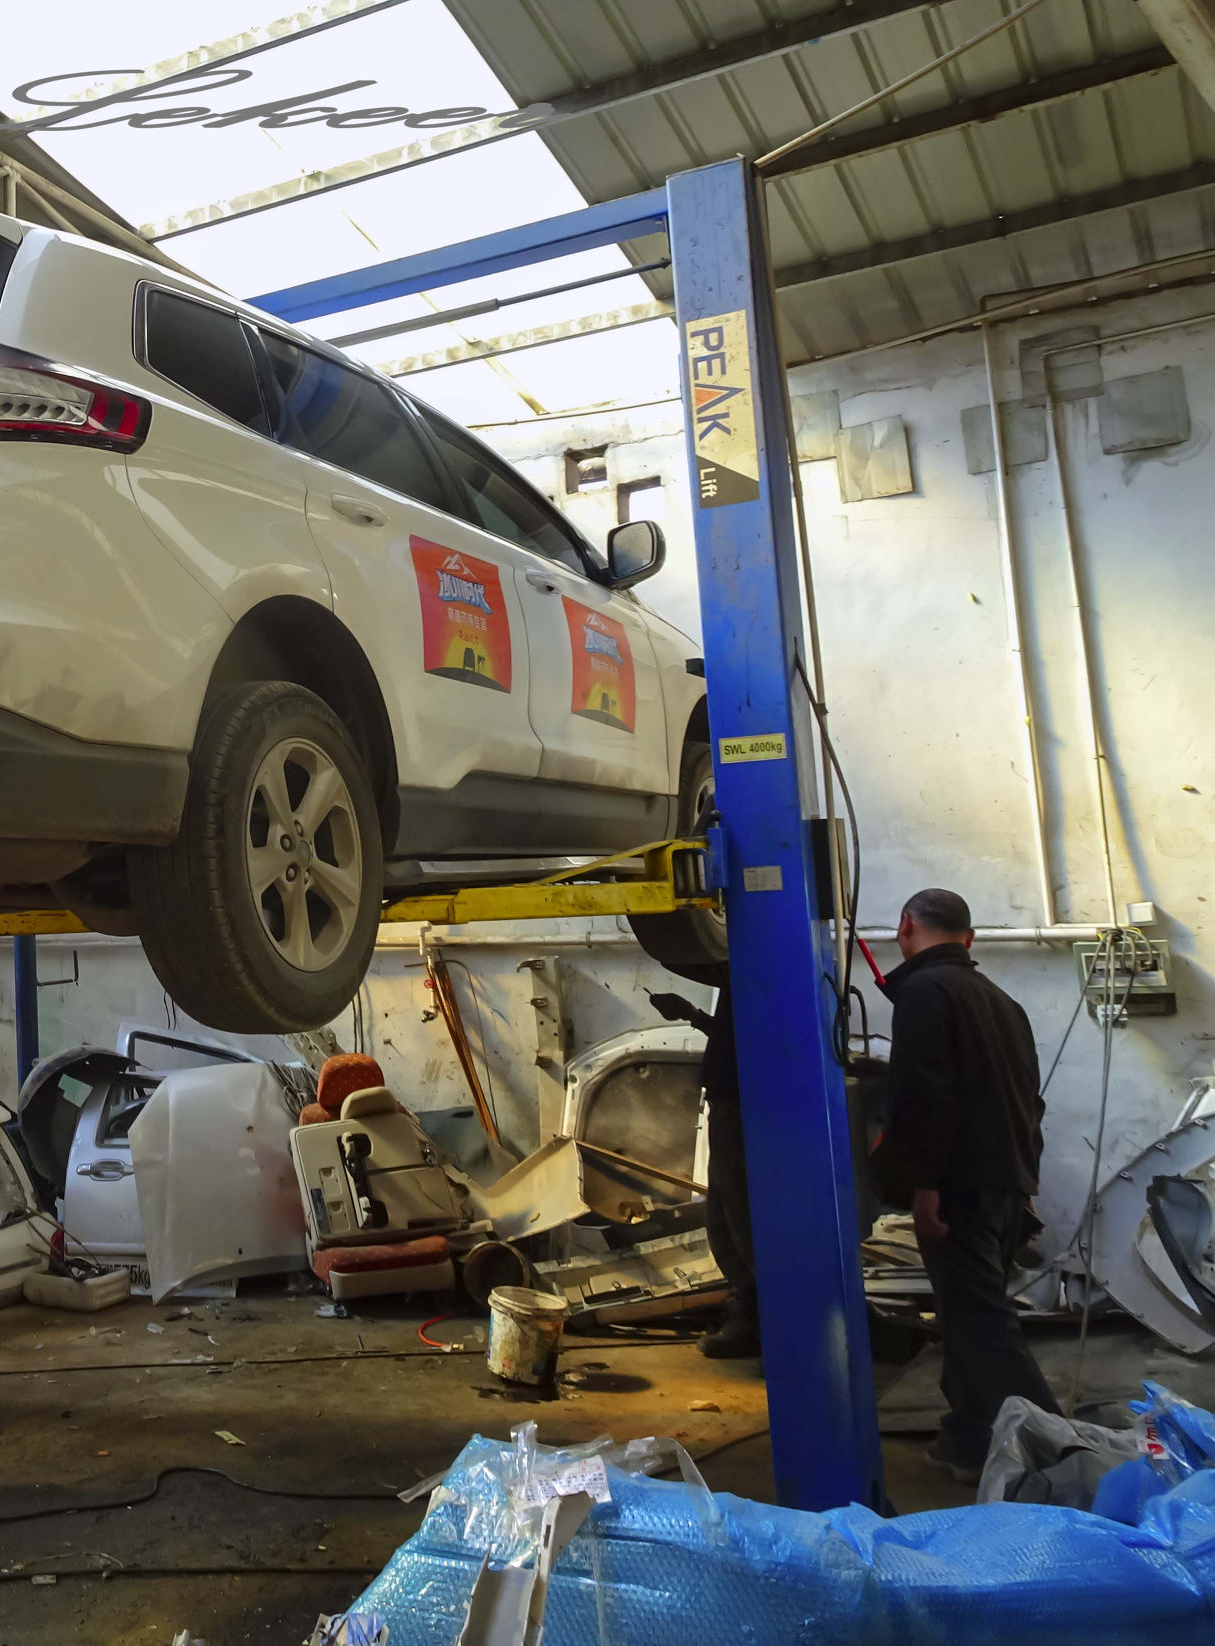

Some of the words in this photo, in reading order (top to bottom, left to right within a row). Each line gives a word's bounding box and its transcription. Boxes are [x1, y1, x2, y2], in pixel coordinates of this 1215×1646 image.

[690, 325, 746, 442] PEAK
[699, 466, 718, 500] Lift
[724, 744, 746, 755] SWL
[749, 740, 783, 753] 4000kg
